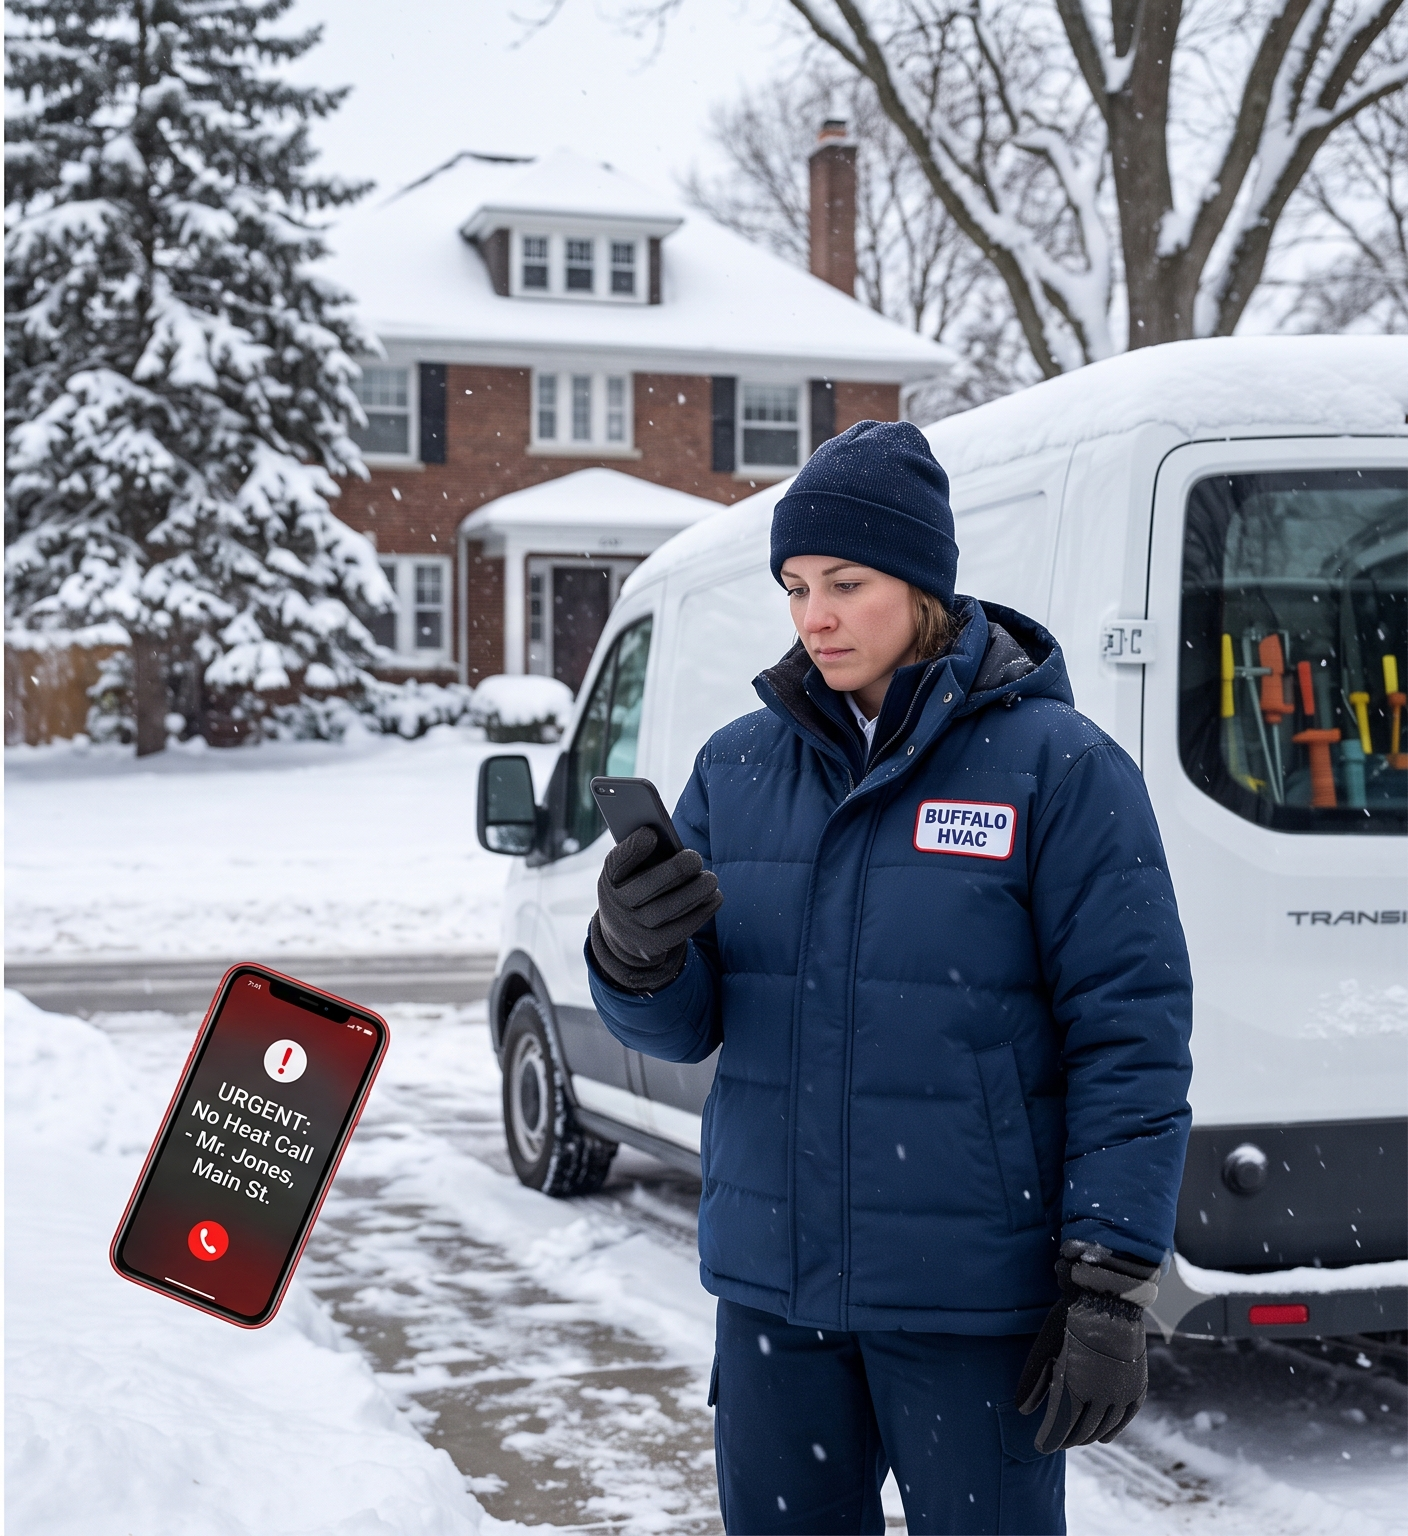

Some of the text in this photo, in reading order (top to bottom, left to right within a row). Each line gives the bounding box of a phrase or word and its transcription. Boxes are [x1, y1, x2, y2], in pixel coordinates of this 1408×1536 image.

[924, 808, 1008, 830] BUFFALO
[937, 828, 988, 848] HVAC
[191, 1100, 315, 1164] No Heat Call
[218, 1081, 311, 1135] URGENT:
[192, 1157, 270, 1205] Main St.
[195, 1130, 225, 1157] Mr.
[231, 1148, 294, 1189] Jones,
